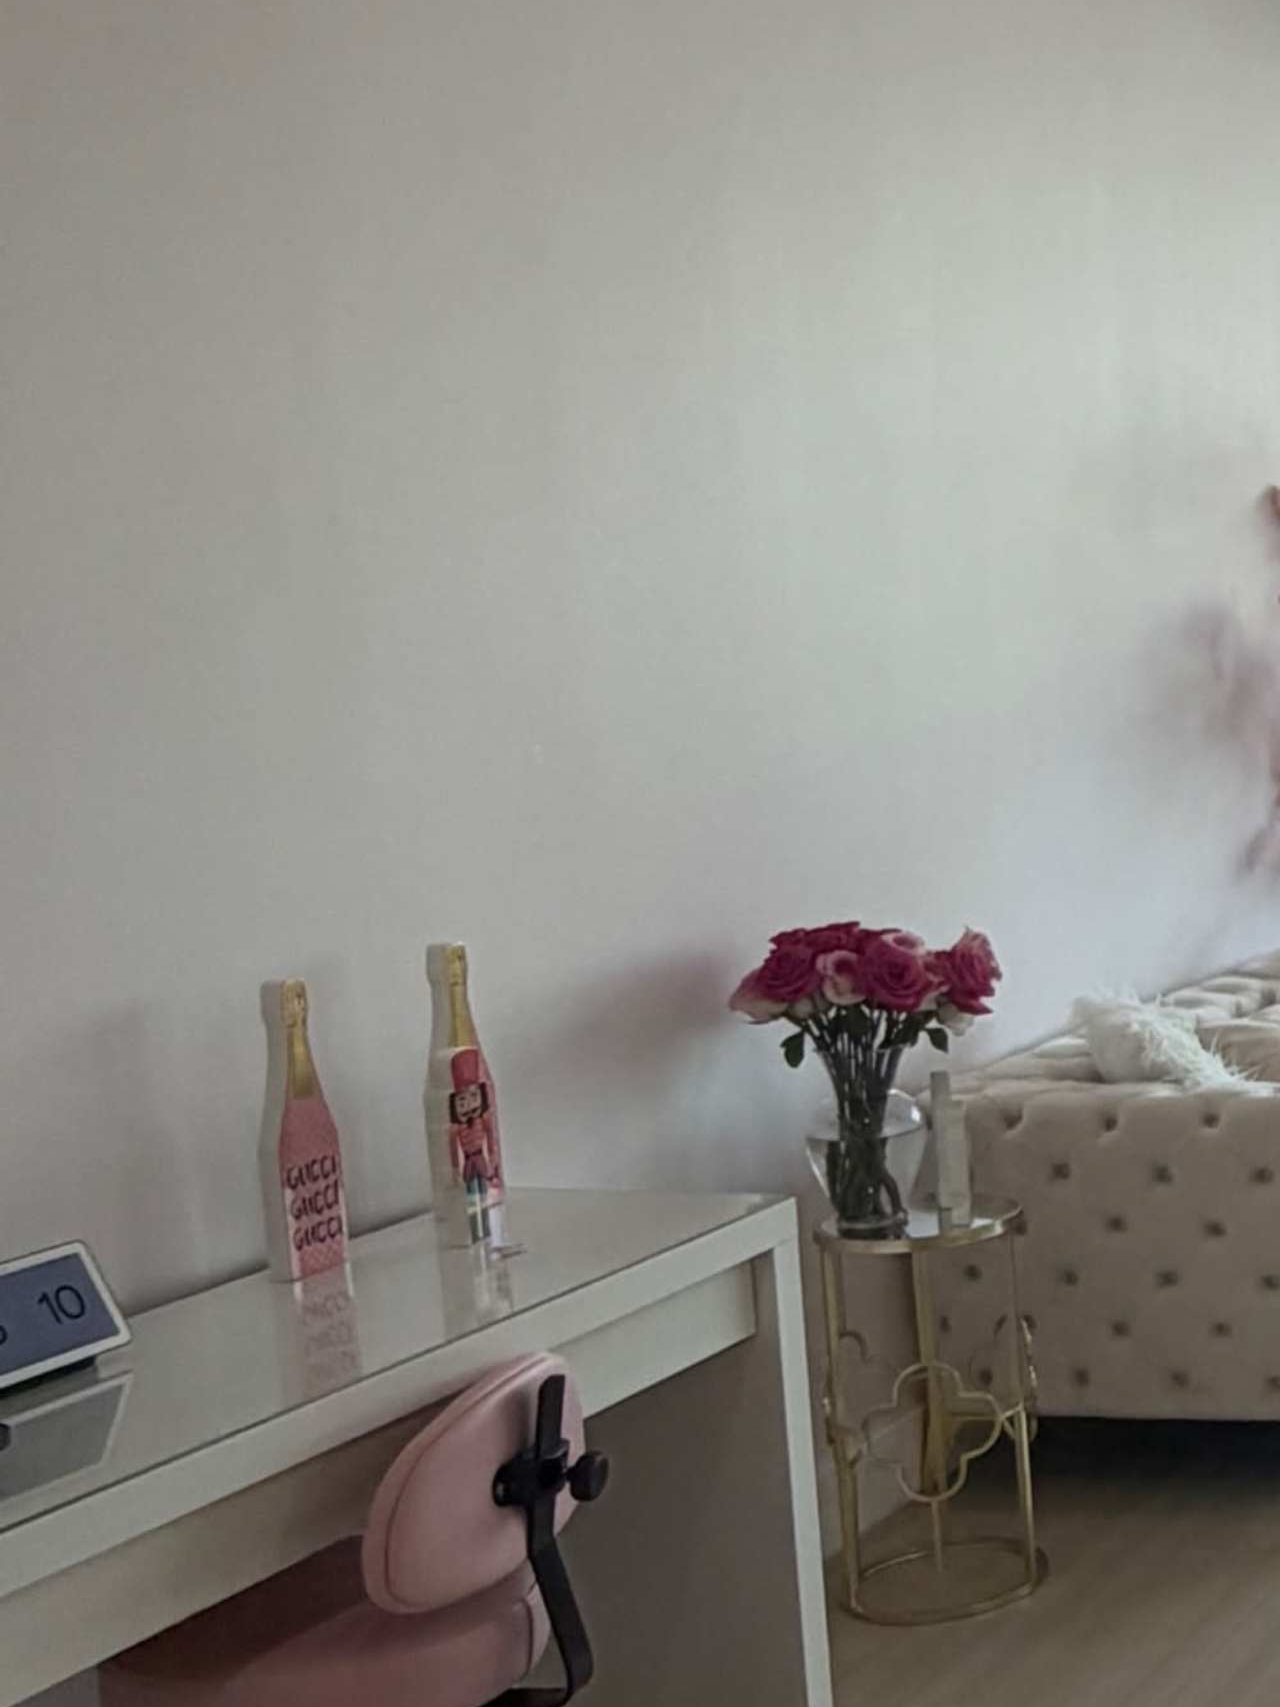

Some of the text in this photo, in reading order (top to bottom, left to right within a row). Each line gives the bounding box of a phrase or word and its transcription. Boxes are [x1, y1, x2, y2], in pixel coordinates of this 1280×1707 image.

[286, 1154, 337, 1191] GUCCI
[290, 1180, 340, 1221] GUCCI
[293, 1215, 344, 1252] GUCCI
[37, 1284, 86, 1325] 10
